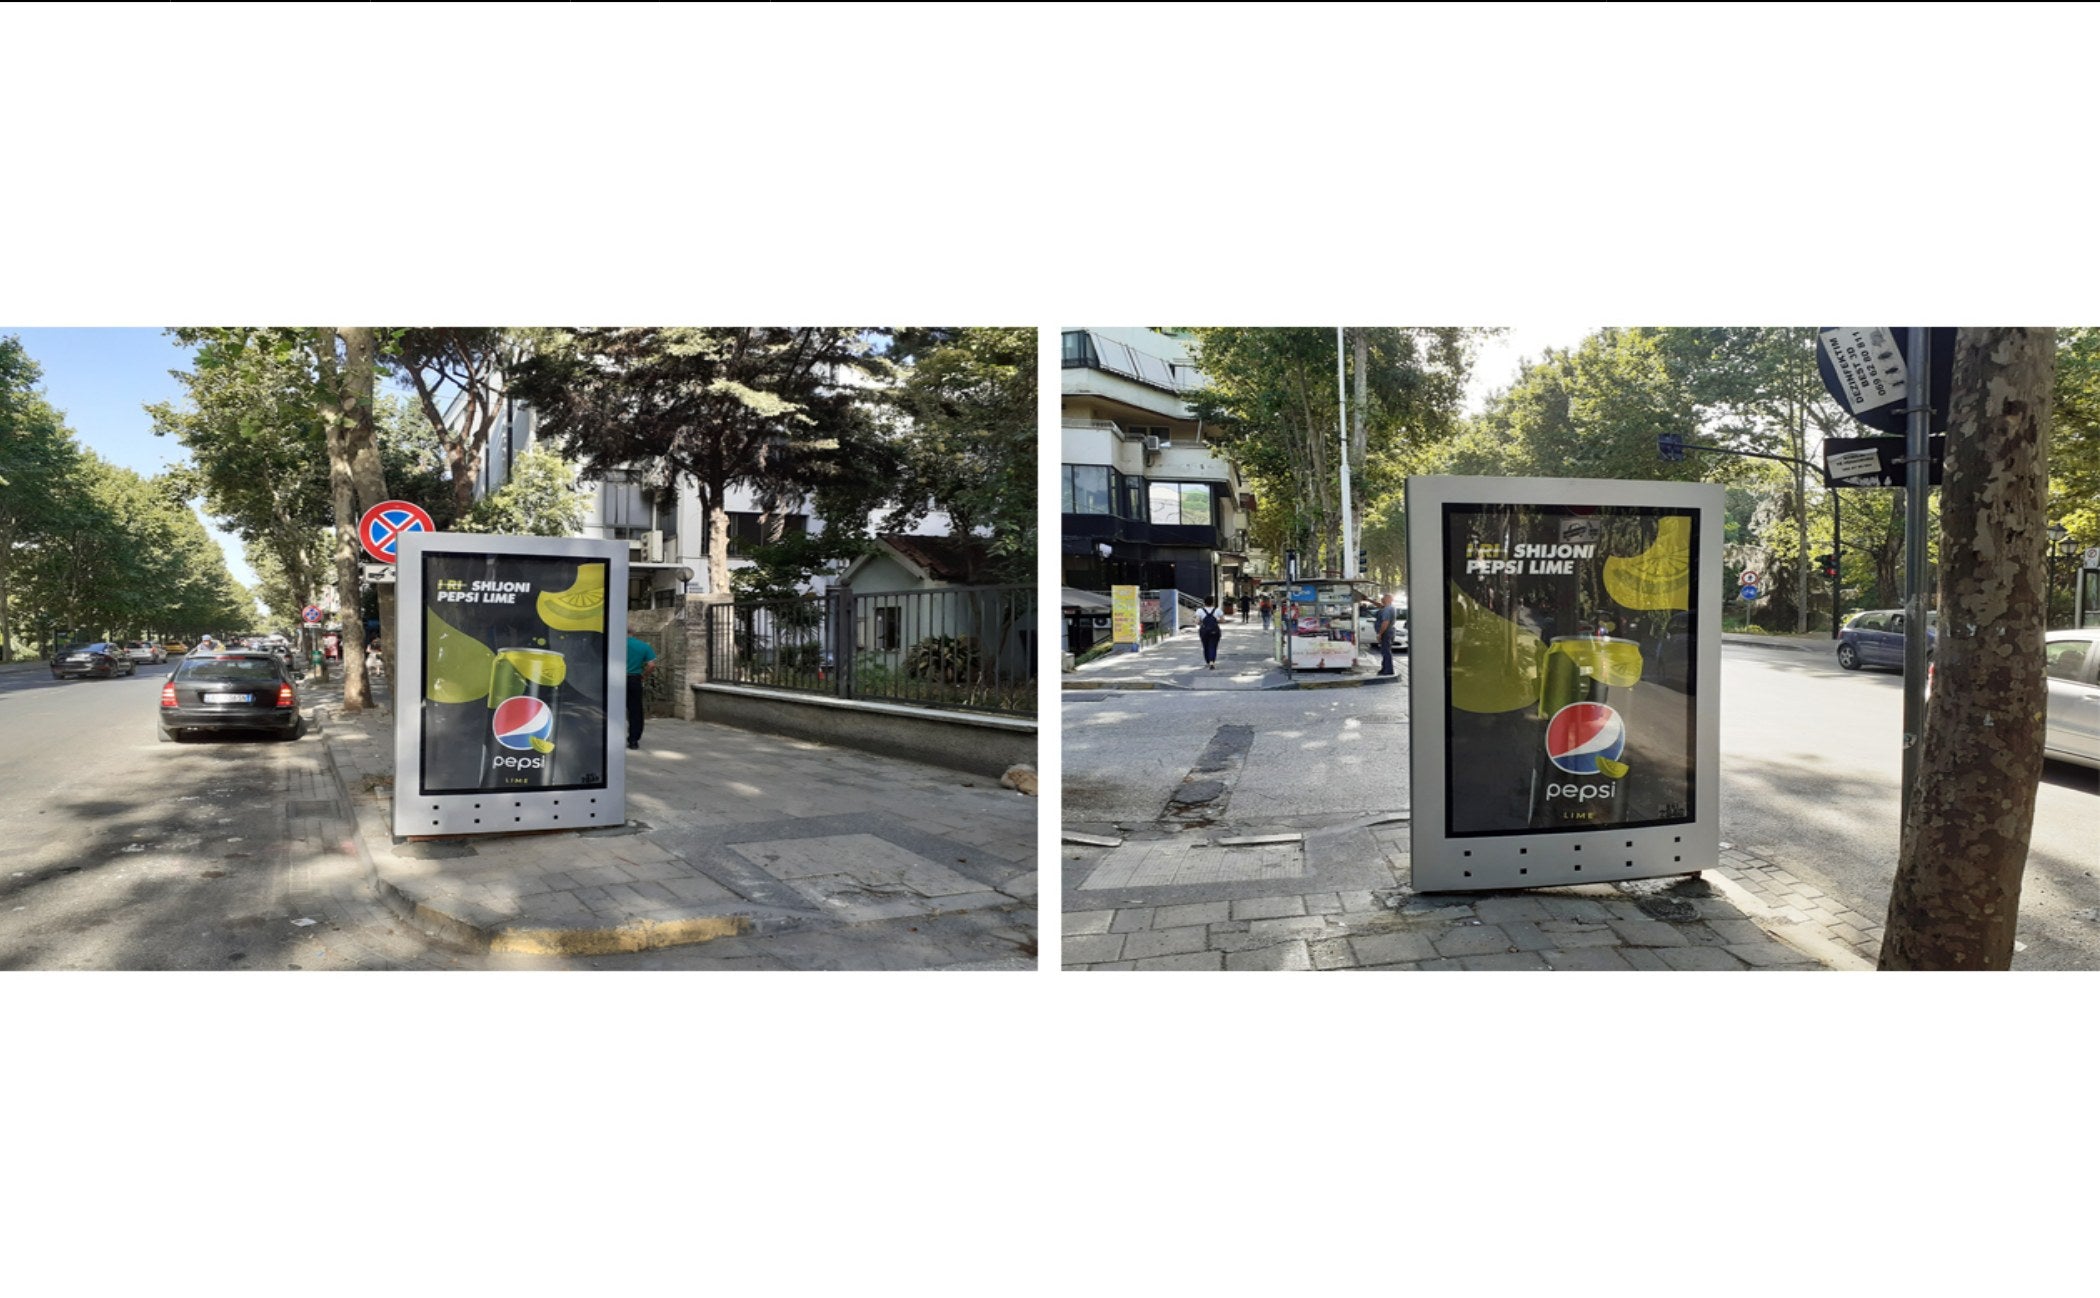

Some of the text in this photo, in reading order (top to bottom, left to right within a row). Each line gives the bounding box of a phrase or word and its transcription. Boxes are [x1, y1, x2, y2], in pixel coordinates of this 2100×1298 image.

[1829, 337, 1864, 404] DEZINFEKTIM
[1853, 362, 1870, 388] BEST
[1513, 543, 1596, 559] SHIJONI
[1466, 559, 1575, 575] PEPSI LIME
[471, 580, 531, 593] SHIJONI
[437, 591, 517, 604] PEPSI LIME
[492, 755, 545, 771] pepsi
[1546, 781, 1616, 802] pepsi
[1563, 812, 1595, 820] LIME
